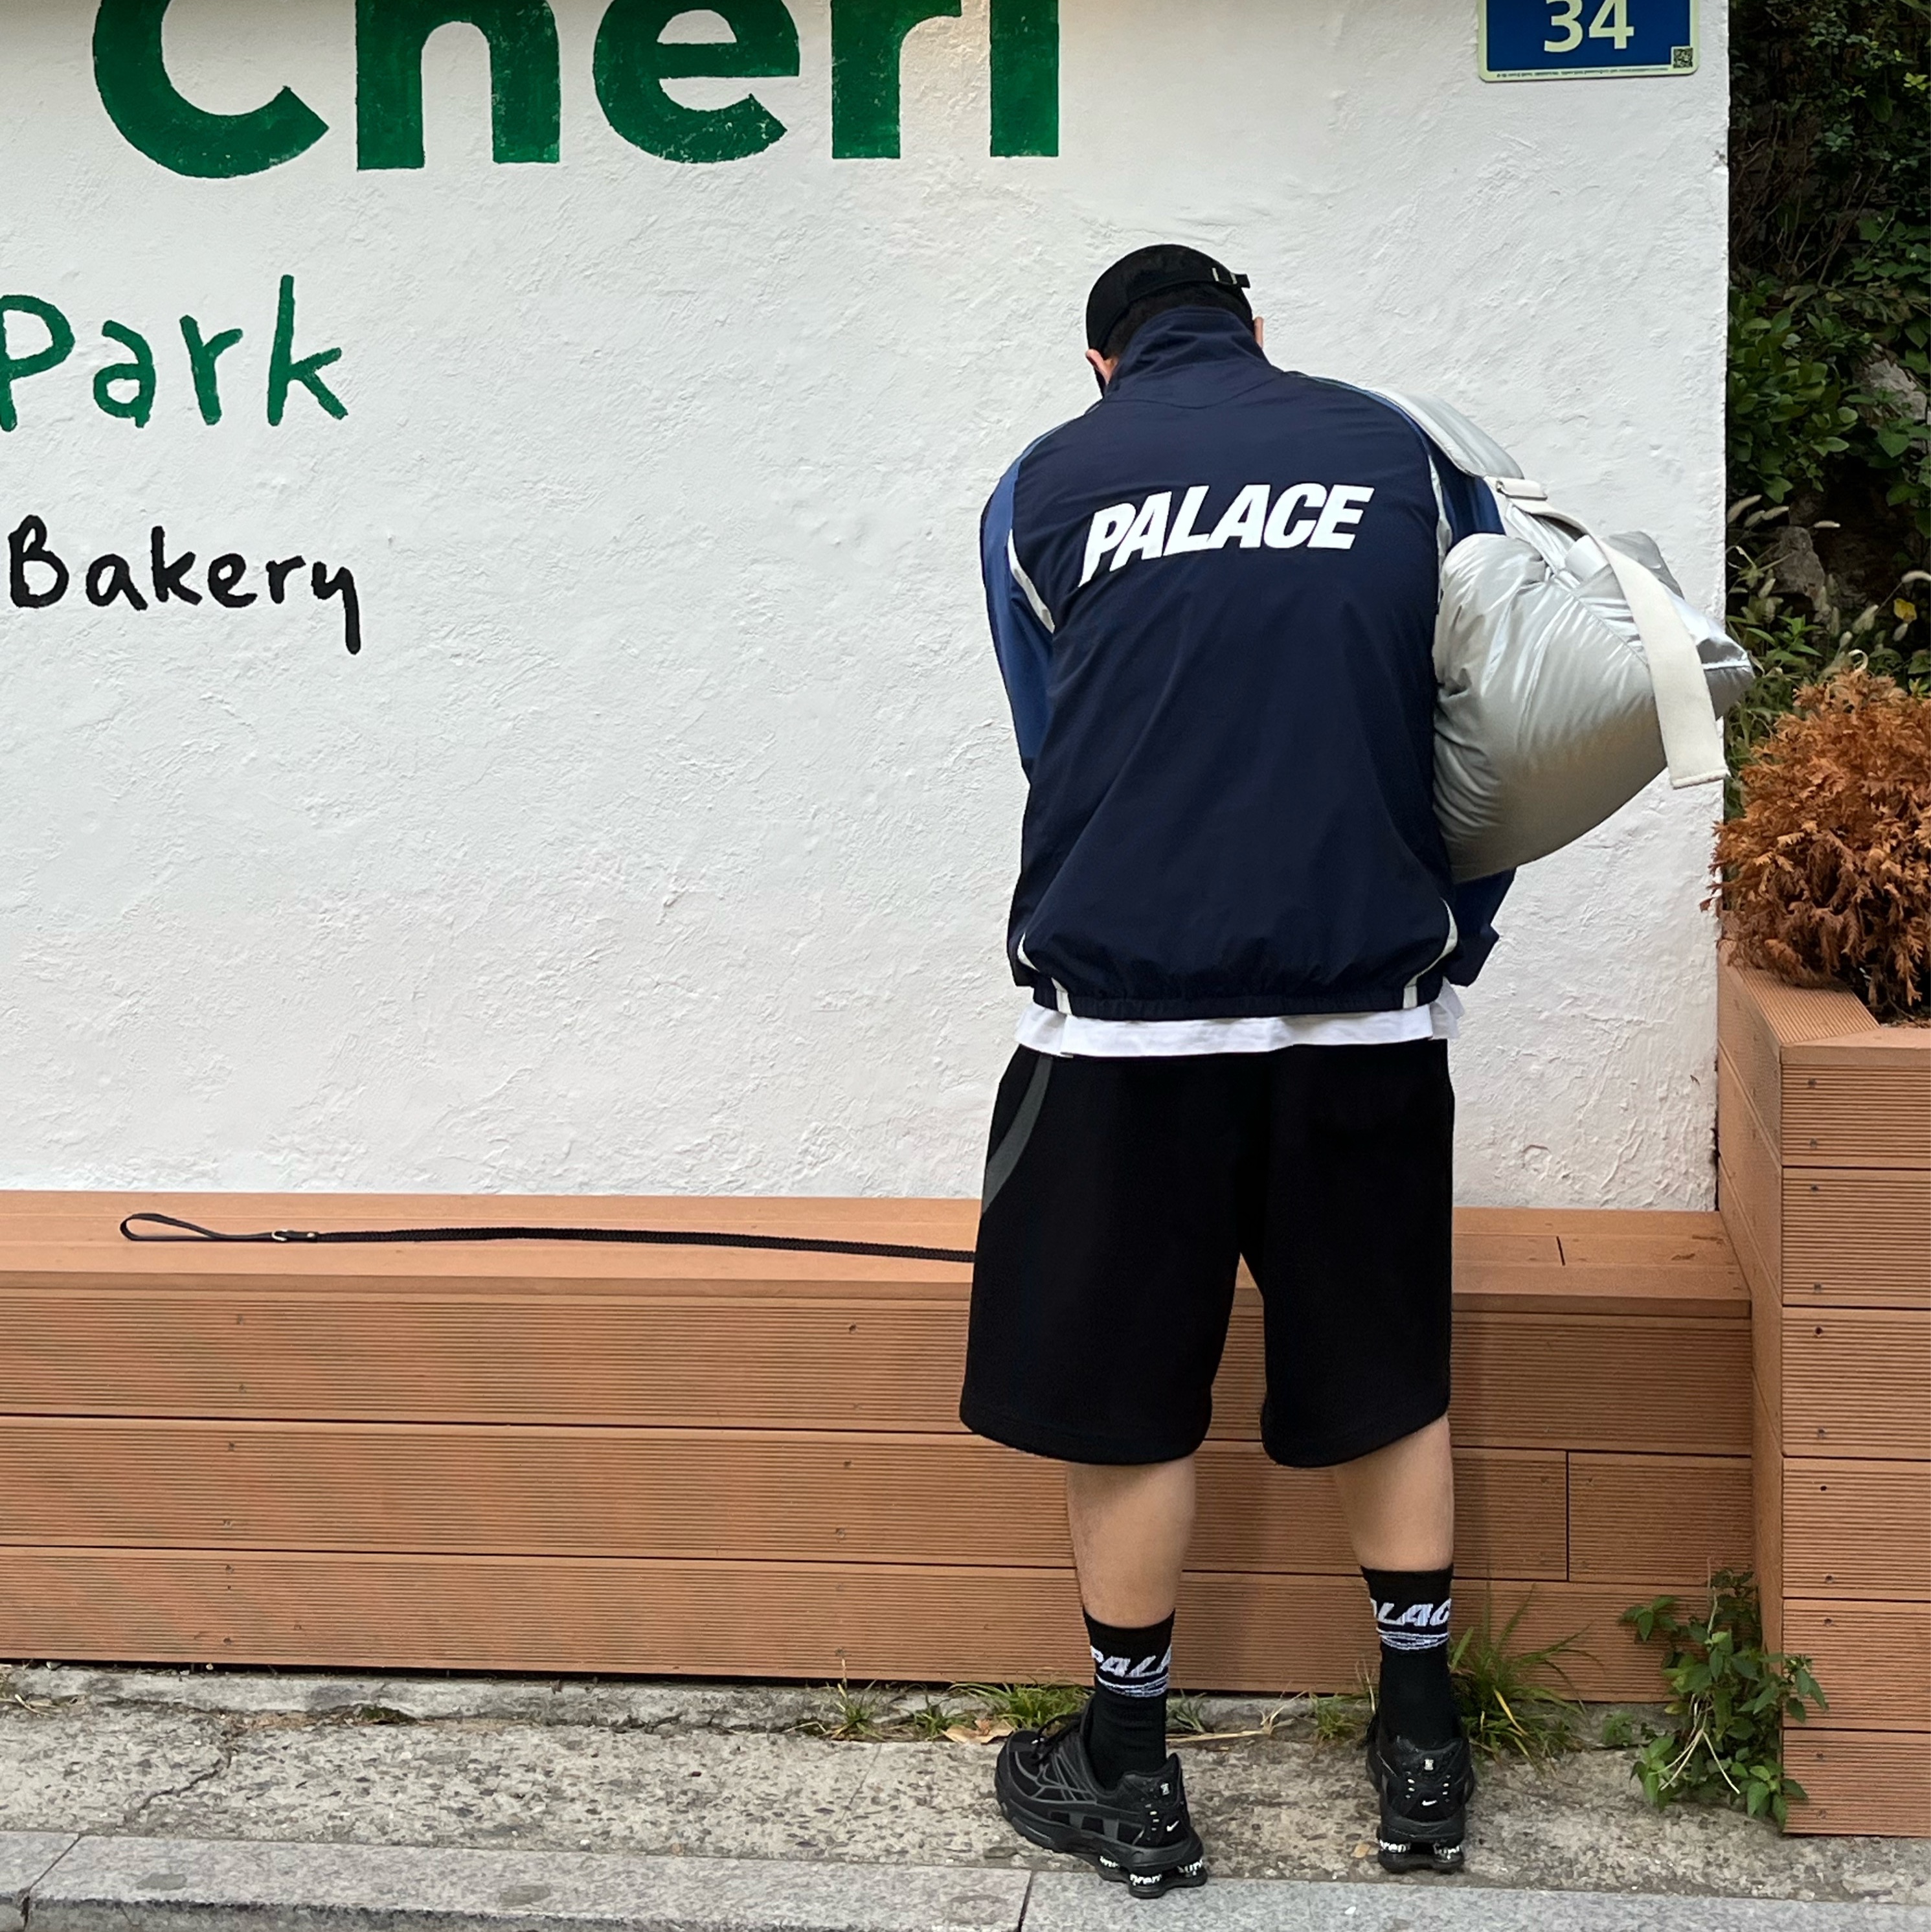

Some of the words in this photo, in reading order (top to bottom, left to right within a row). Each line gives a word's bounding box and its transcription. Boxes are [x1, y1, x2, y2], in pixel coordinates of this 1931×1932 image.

[1544, 0, 1634, 53] 34
[0, 275, 348, 431] Park
[8, 514, 361, 655] Bakery
[1078, 483, 1375, 587] PALACE
